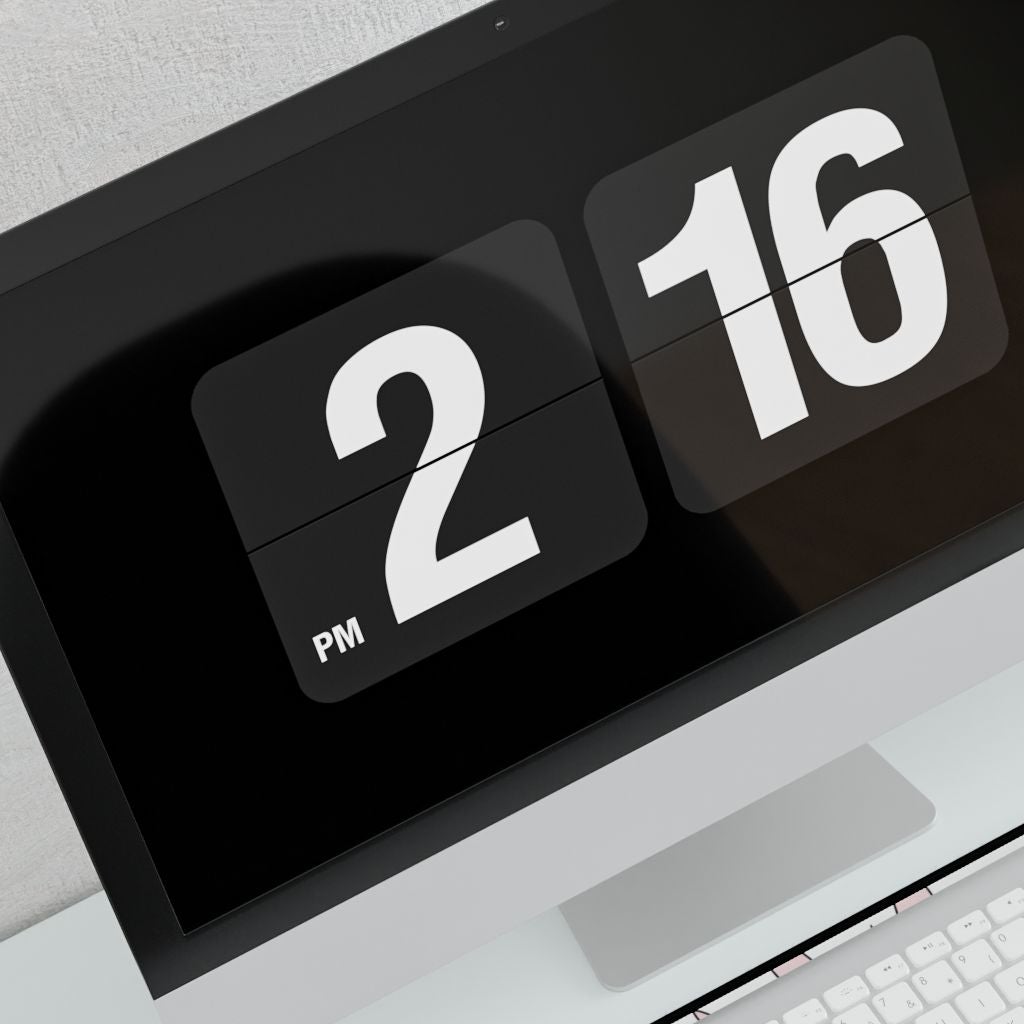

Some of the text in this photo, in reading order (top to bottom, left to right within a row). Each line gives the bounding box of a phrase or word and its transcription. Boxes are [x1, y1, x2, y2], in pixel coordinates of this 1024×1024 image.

[326, 107, 947, 624] 2 16
[312, 616, 365, 663] PM
